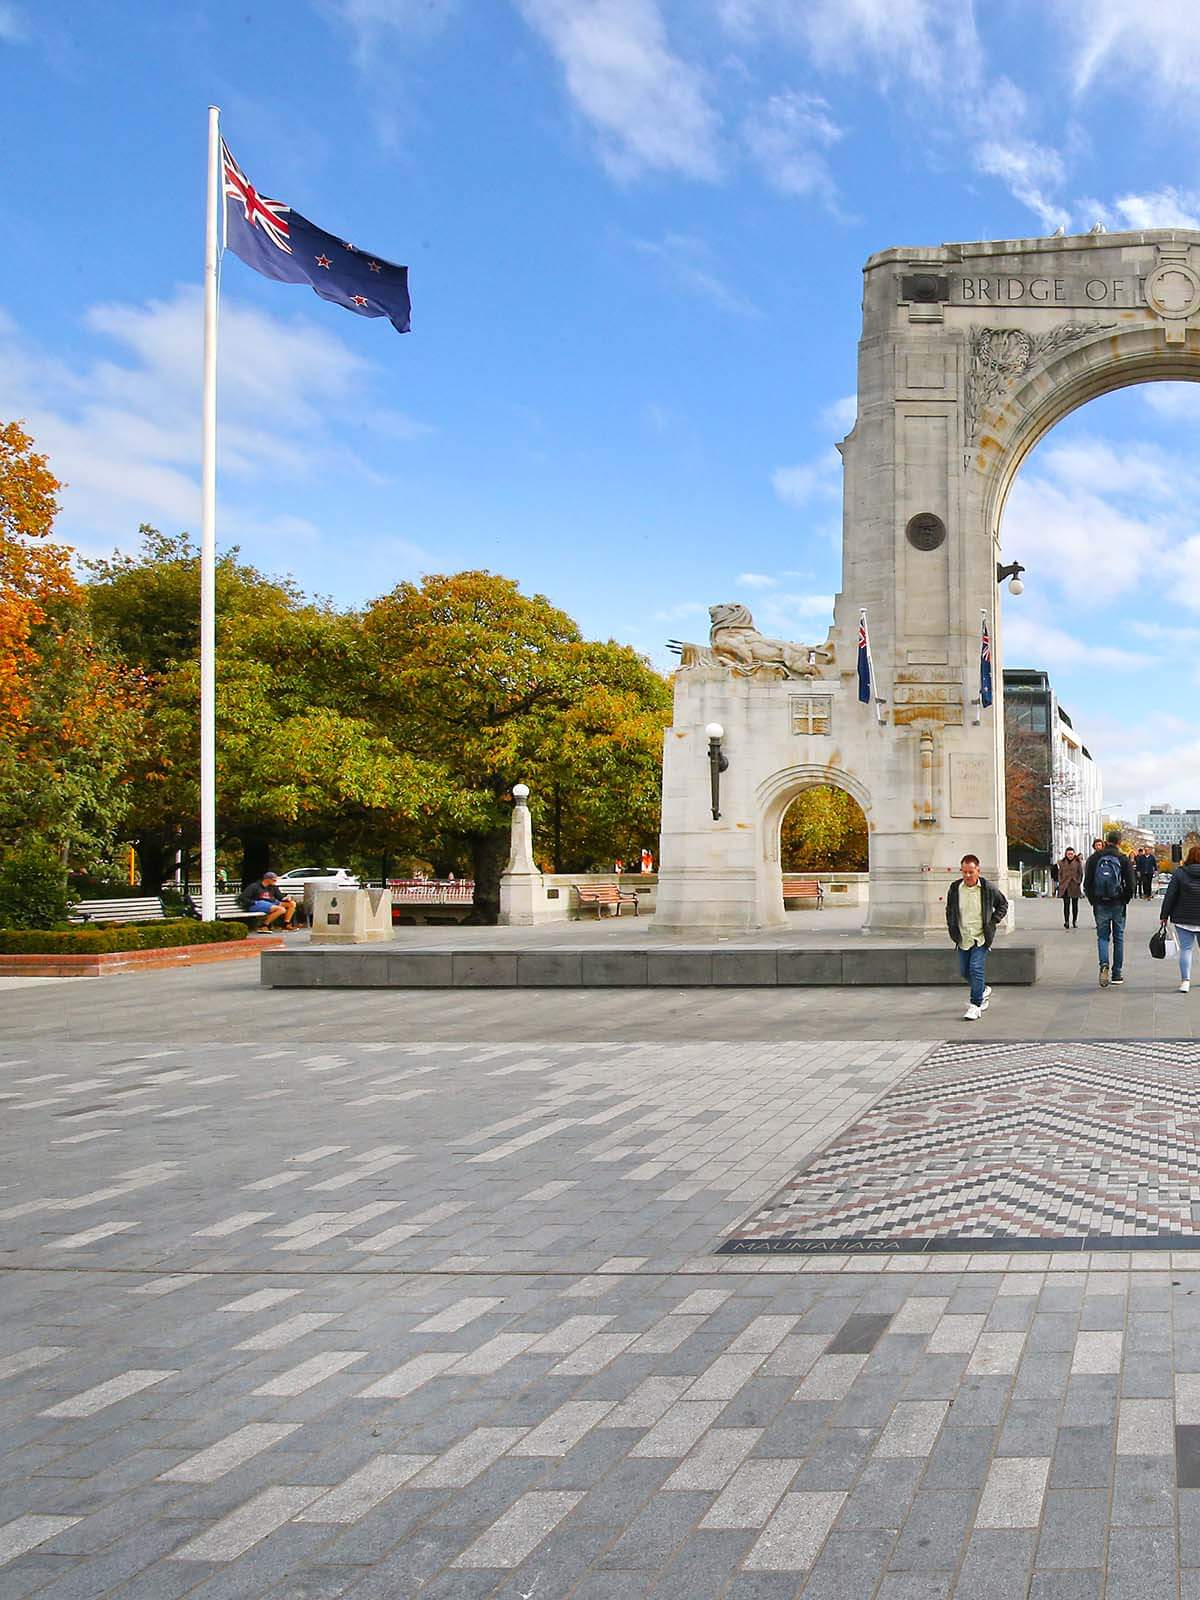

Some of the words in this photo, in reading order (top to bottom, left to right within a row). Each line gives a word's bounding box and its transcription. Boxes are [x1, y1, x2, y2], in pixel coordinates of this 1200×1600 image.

[962, 278, 1066, 301] BRIDGE
[1085, 279, 1124, 302] OF
[901, 687, 955, 701] FRANCE
[733, 1241, 902, 1250] MAUMAHARA
